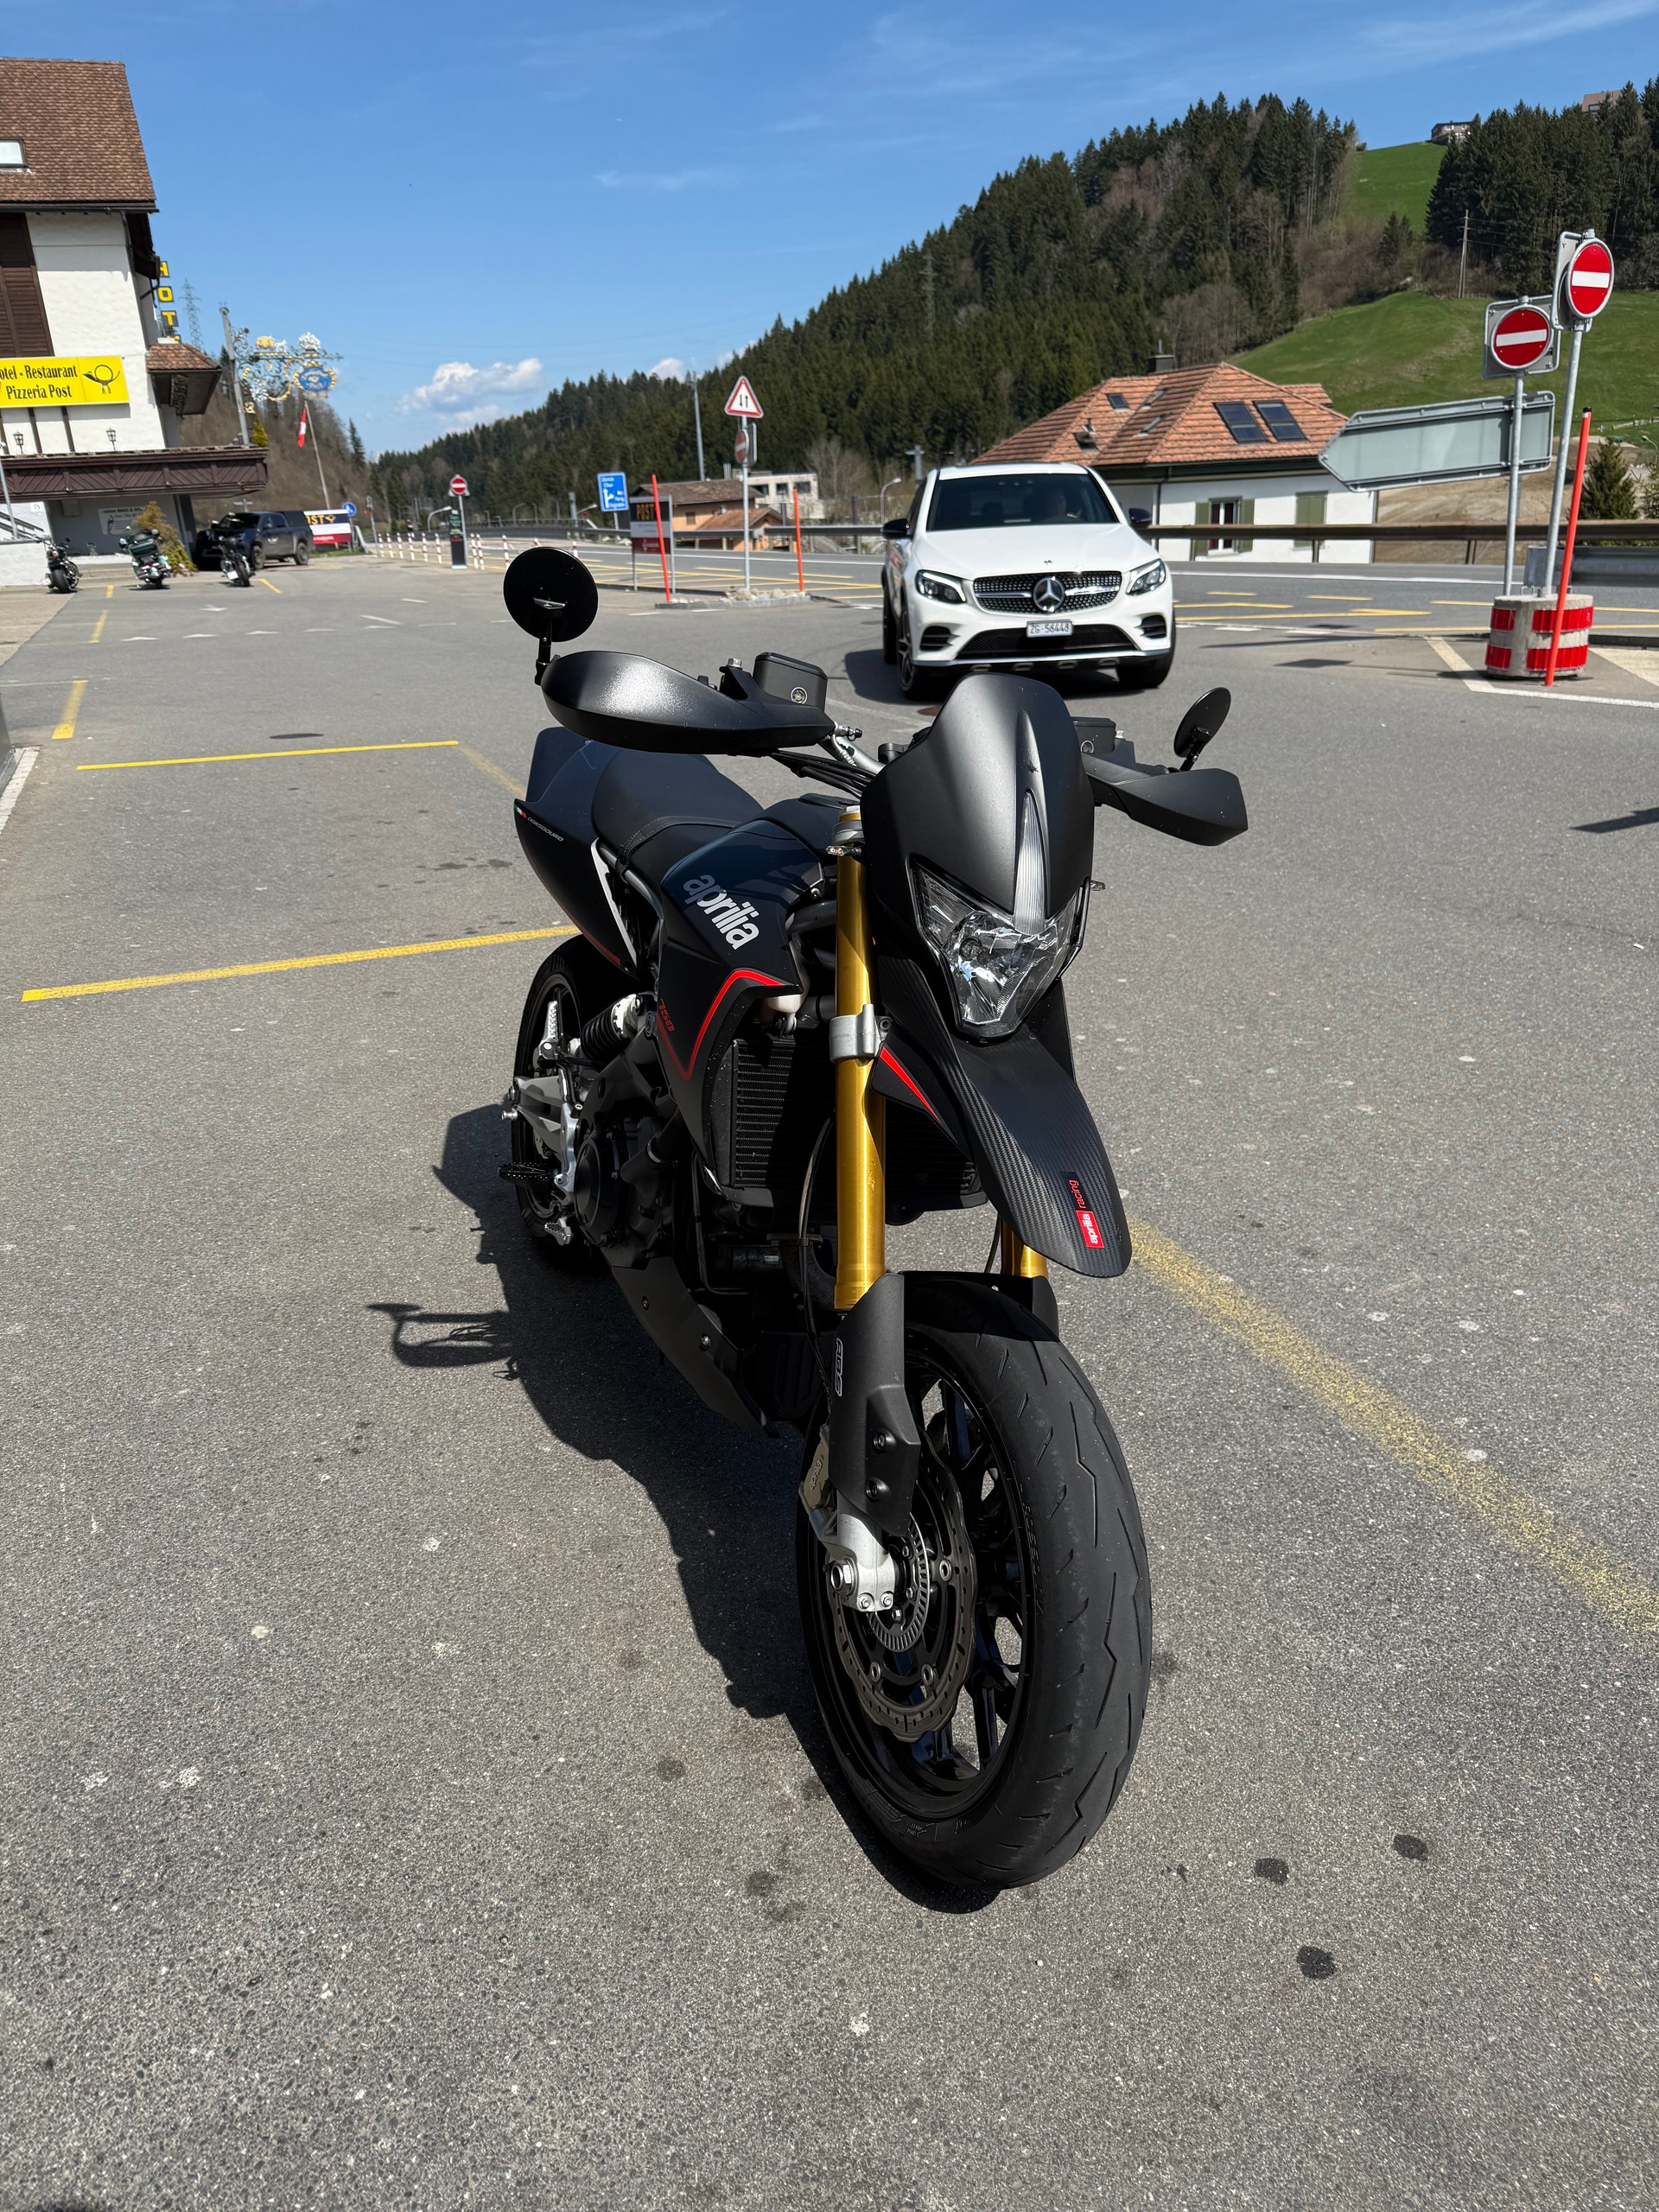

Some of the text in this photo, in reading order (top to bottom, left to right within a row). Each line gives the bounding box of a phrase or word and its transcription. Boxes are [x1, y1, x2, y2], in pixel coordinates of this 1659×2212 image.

[24, 365, 78, 379] Restaurant
[5, 384, 73, 400] Pizzeria Post
[527, 817, 564, 842] DORSODURO
[683, 874, 760, 950] aprilia
[658, 998, 675, 1032] 750
[1069, 1179, 1098, 1244] aprilia racing
[835, 1338, 843, 1397] ABS
